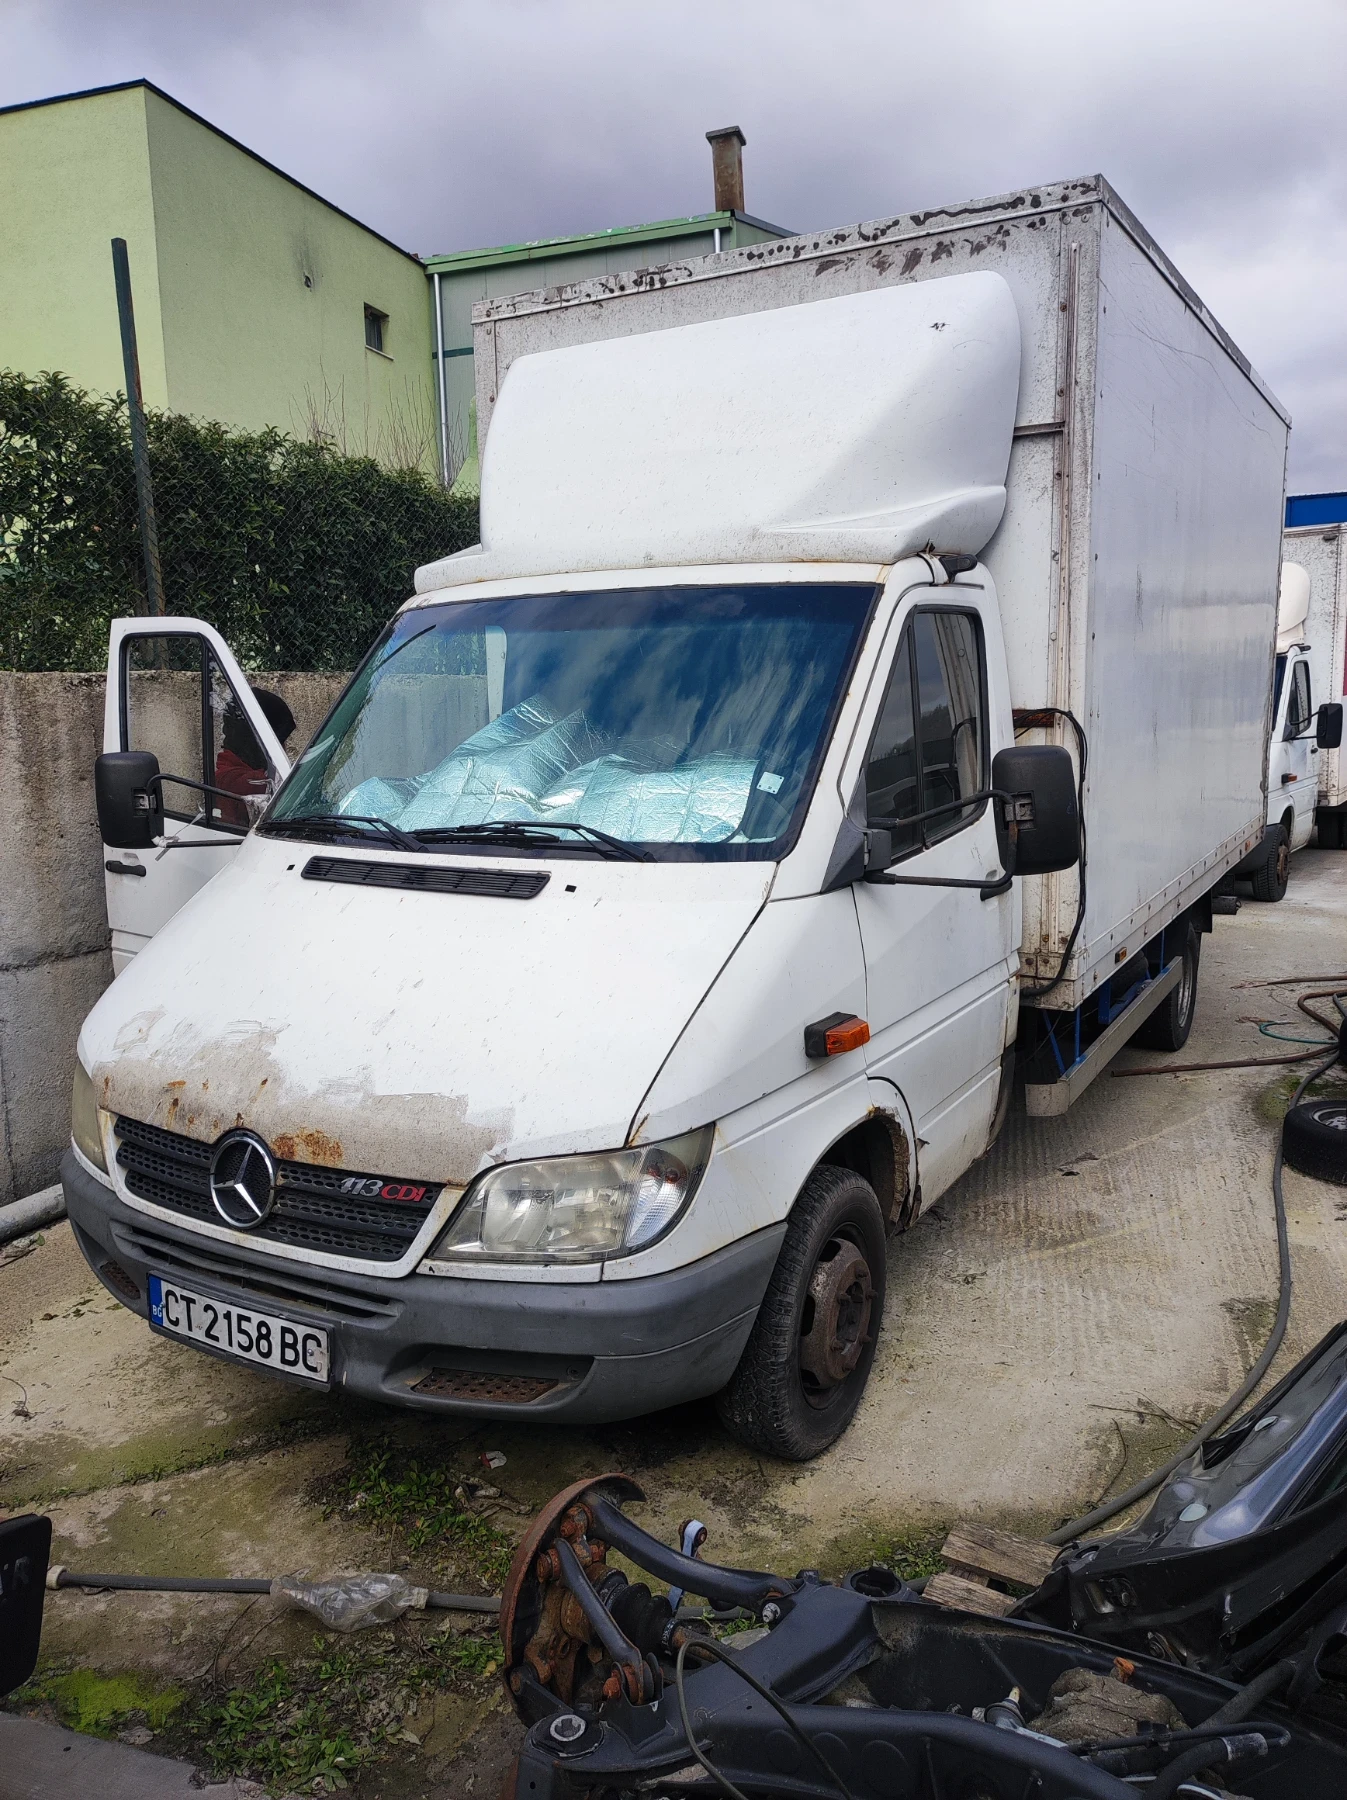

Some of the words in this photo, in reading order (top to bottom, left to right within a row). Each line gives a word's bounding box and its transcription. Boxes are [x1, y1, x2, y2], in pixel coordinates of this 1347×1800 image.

[381, 1184, 427, 1202] CDI
[152, 1304, 163, 1318] BG
[164, 1289, 197, 1332] CT
[203, 1303, 273, 1360] 2158
[280, 1325, 322, 1374] BC
